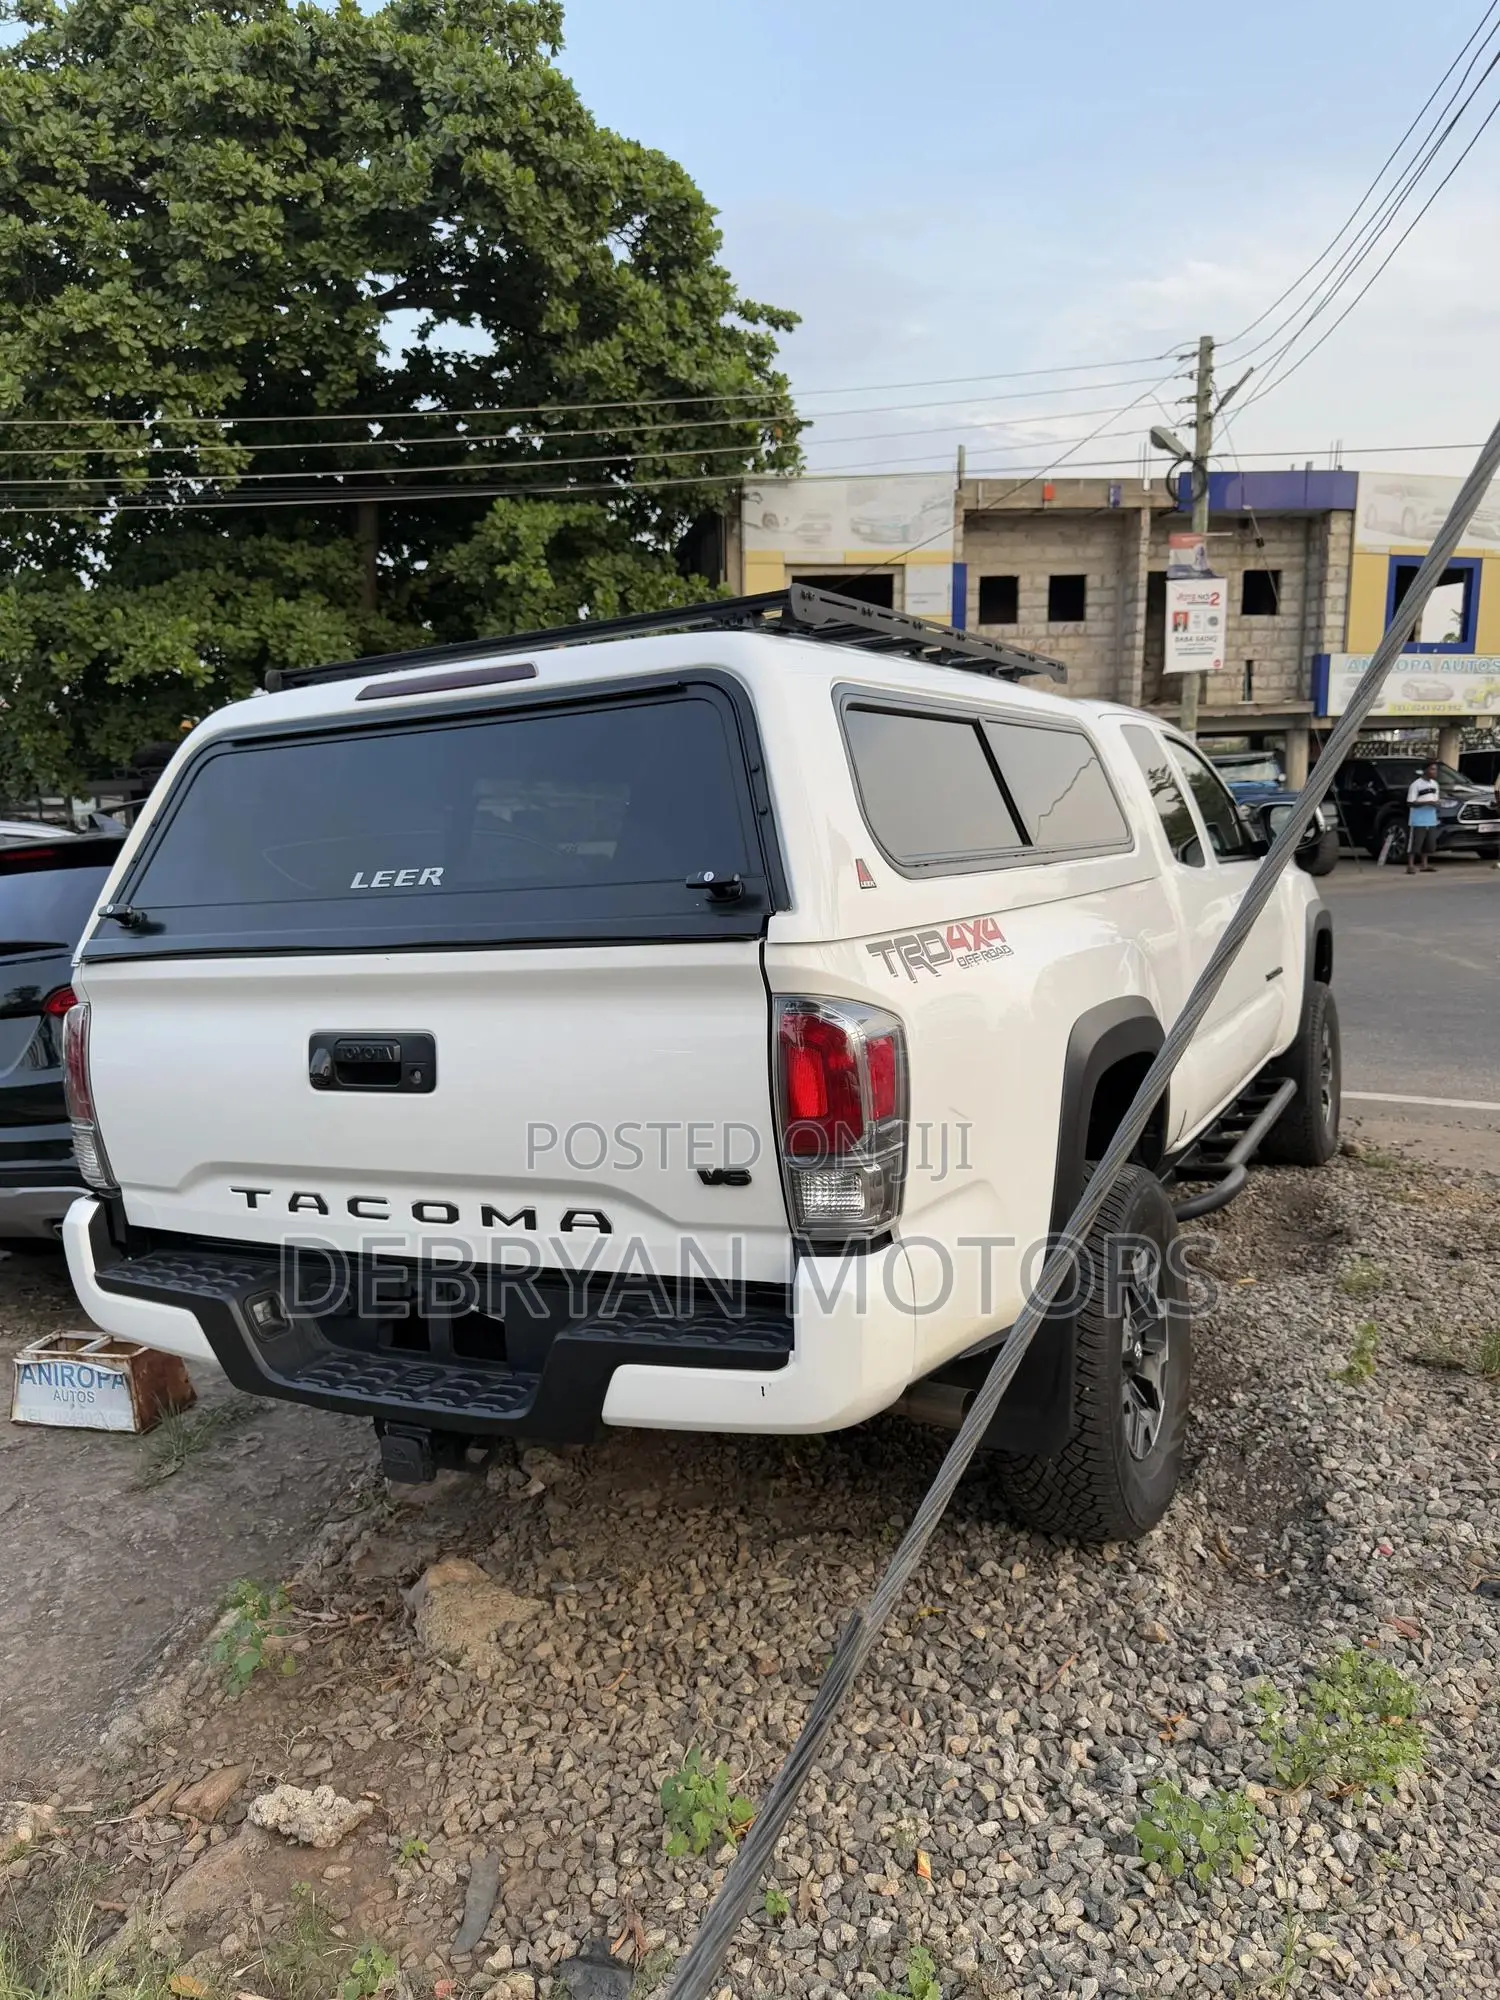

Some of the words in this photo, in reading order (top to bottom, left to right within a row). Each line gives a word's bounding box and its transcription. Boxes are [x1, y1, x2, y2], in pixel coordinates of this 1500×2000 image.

[1209, 592, 1220, 606] 2
[1347, 659, 1432, 672] ANOPA
[350, 867, 444, 889] LEER
[865, 929, 954, 984] TRD
[956, 952, 980, 969] OFF
[980, 944, 1014, 964] ROAD
[337, 1044, 394, 1061] TOYOTA
[696, 1167, 752, 1187] V6
[229, 1185, 613, 1234] TACOMA
[20, 1363, 126, 1390] ANIROPA
[53, 1389, 95, 1403] AUTOS
